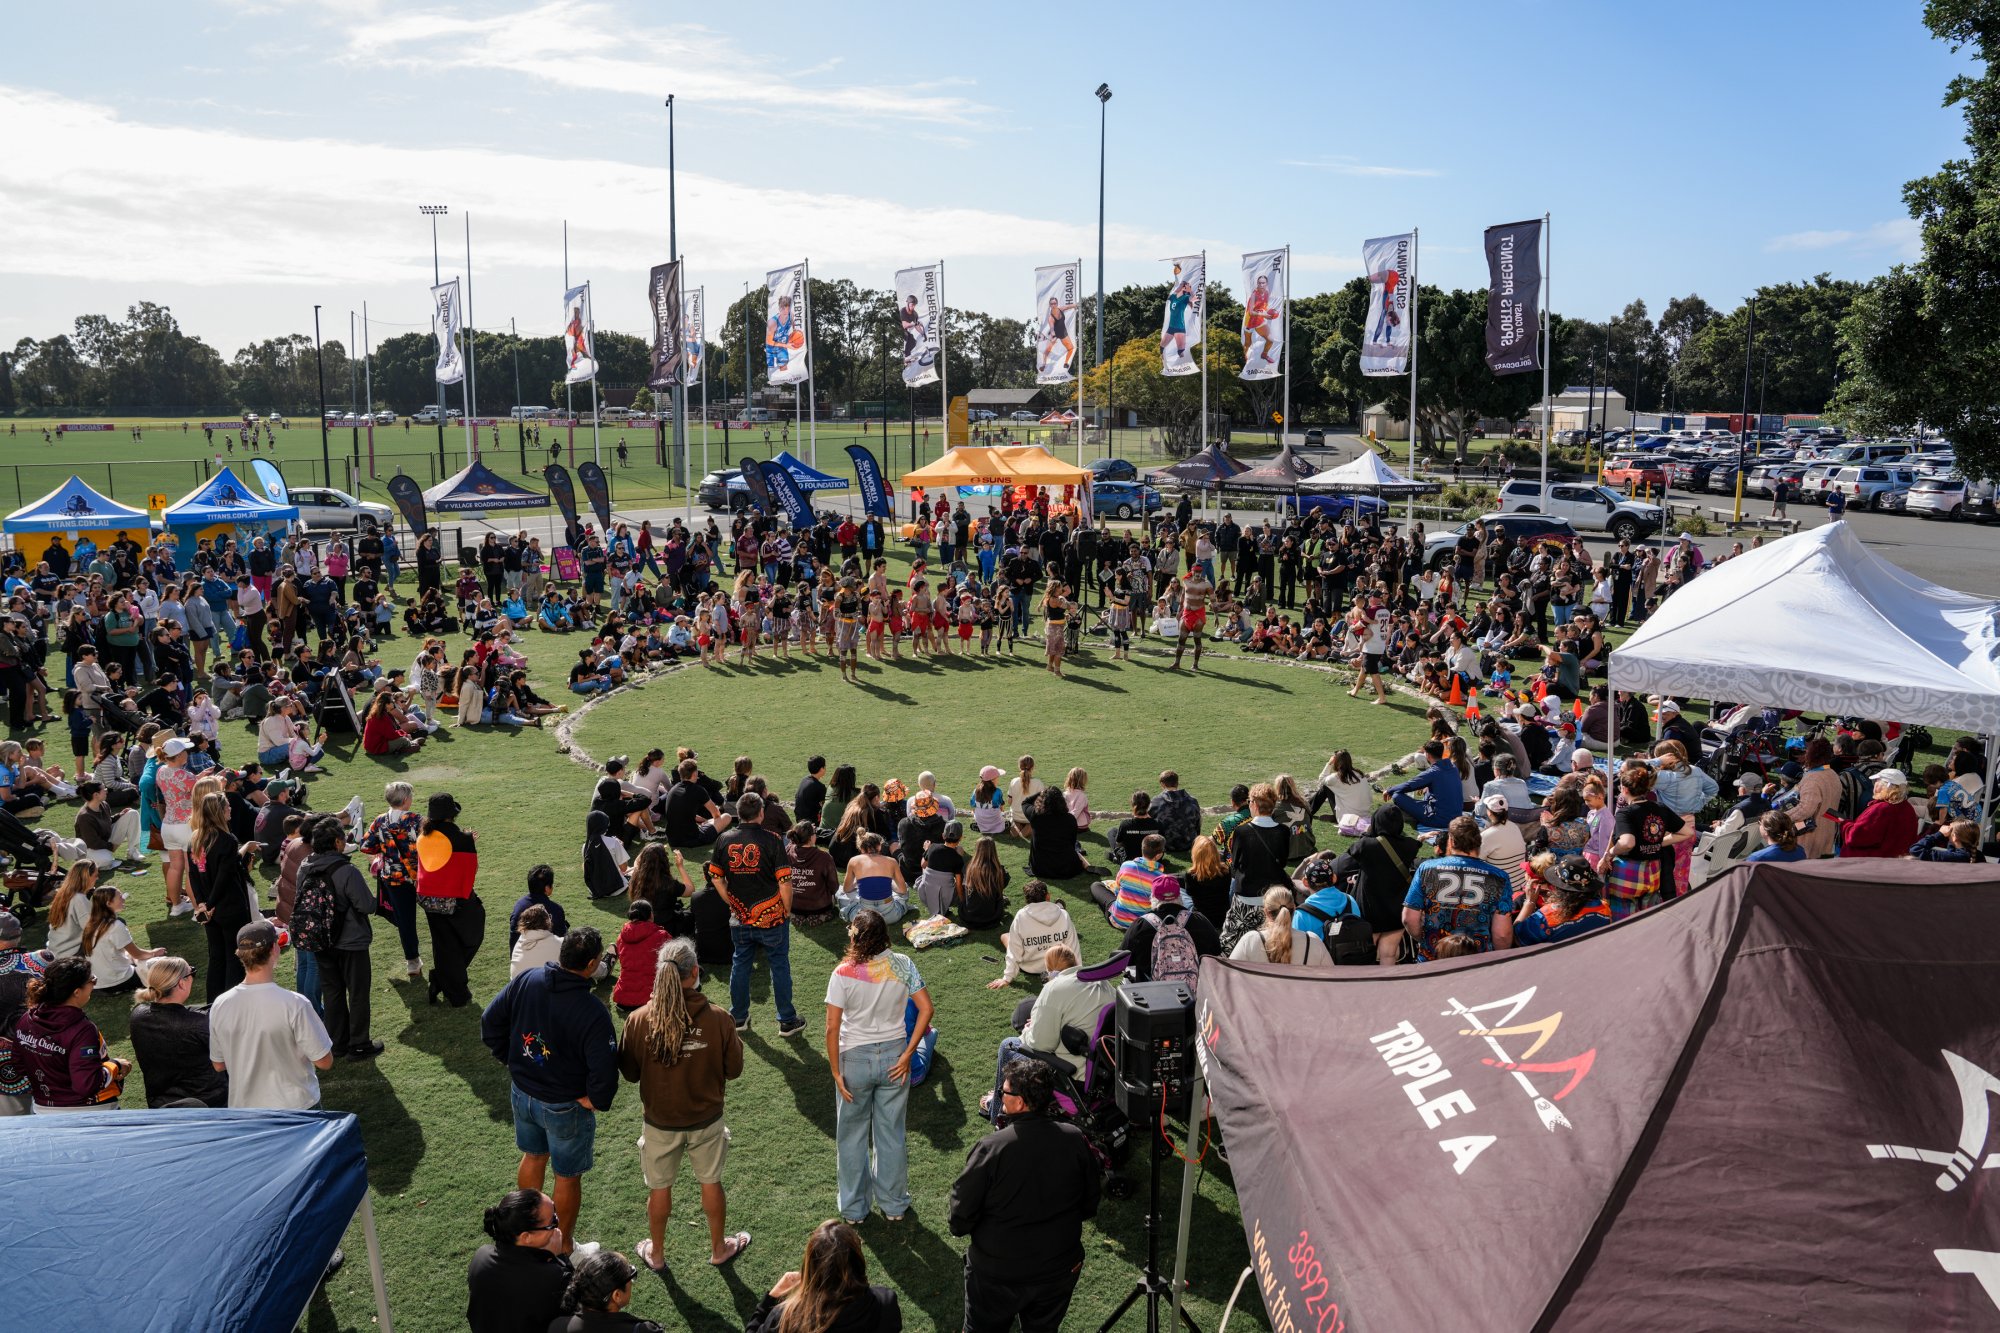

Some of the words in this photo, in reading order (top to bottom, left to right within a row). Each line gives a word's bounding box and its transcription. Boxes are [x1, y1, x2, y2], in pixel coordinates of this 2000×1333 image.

[862, 459, 870, 474] SEA
[805, 481, 848, 490] FOUNDATION
[854, 458, 873, 507] FOUNDATION
[864, 473, 879, 503] WORLD
[982, 476, 1012, 484] SUNS
[527, 498, 546, 506] PARKS
[768, 473, 798, 521] FOUNDATION
[775, 472, 785, 486] SEA
[783, 486, 801, 514] WORLD
[47, 518, 110, 529] TITANS.COM.AU
[206, 511, 259, 521] TITANS.COM.AU
[727, 843, 761, 868] 50
[1436, 864, 1461, 872] DEADLY
[1462, 866, 1489, 875] CHOICES
[1436, 872, 1487, 905] 25
[1023, 934, 1052, 947] LEISURE
[15, 1029, 38, 1047] Deadly
[38, 1037, 67, 1055] Choices
[1369, 1020, 1477, 1130] TRIPLE
[1438, 1134, 1498, 1176] A
